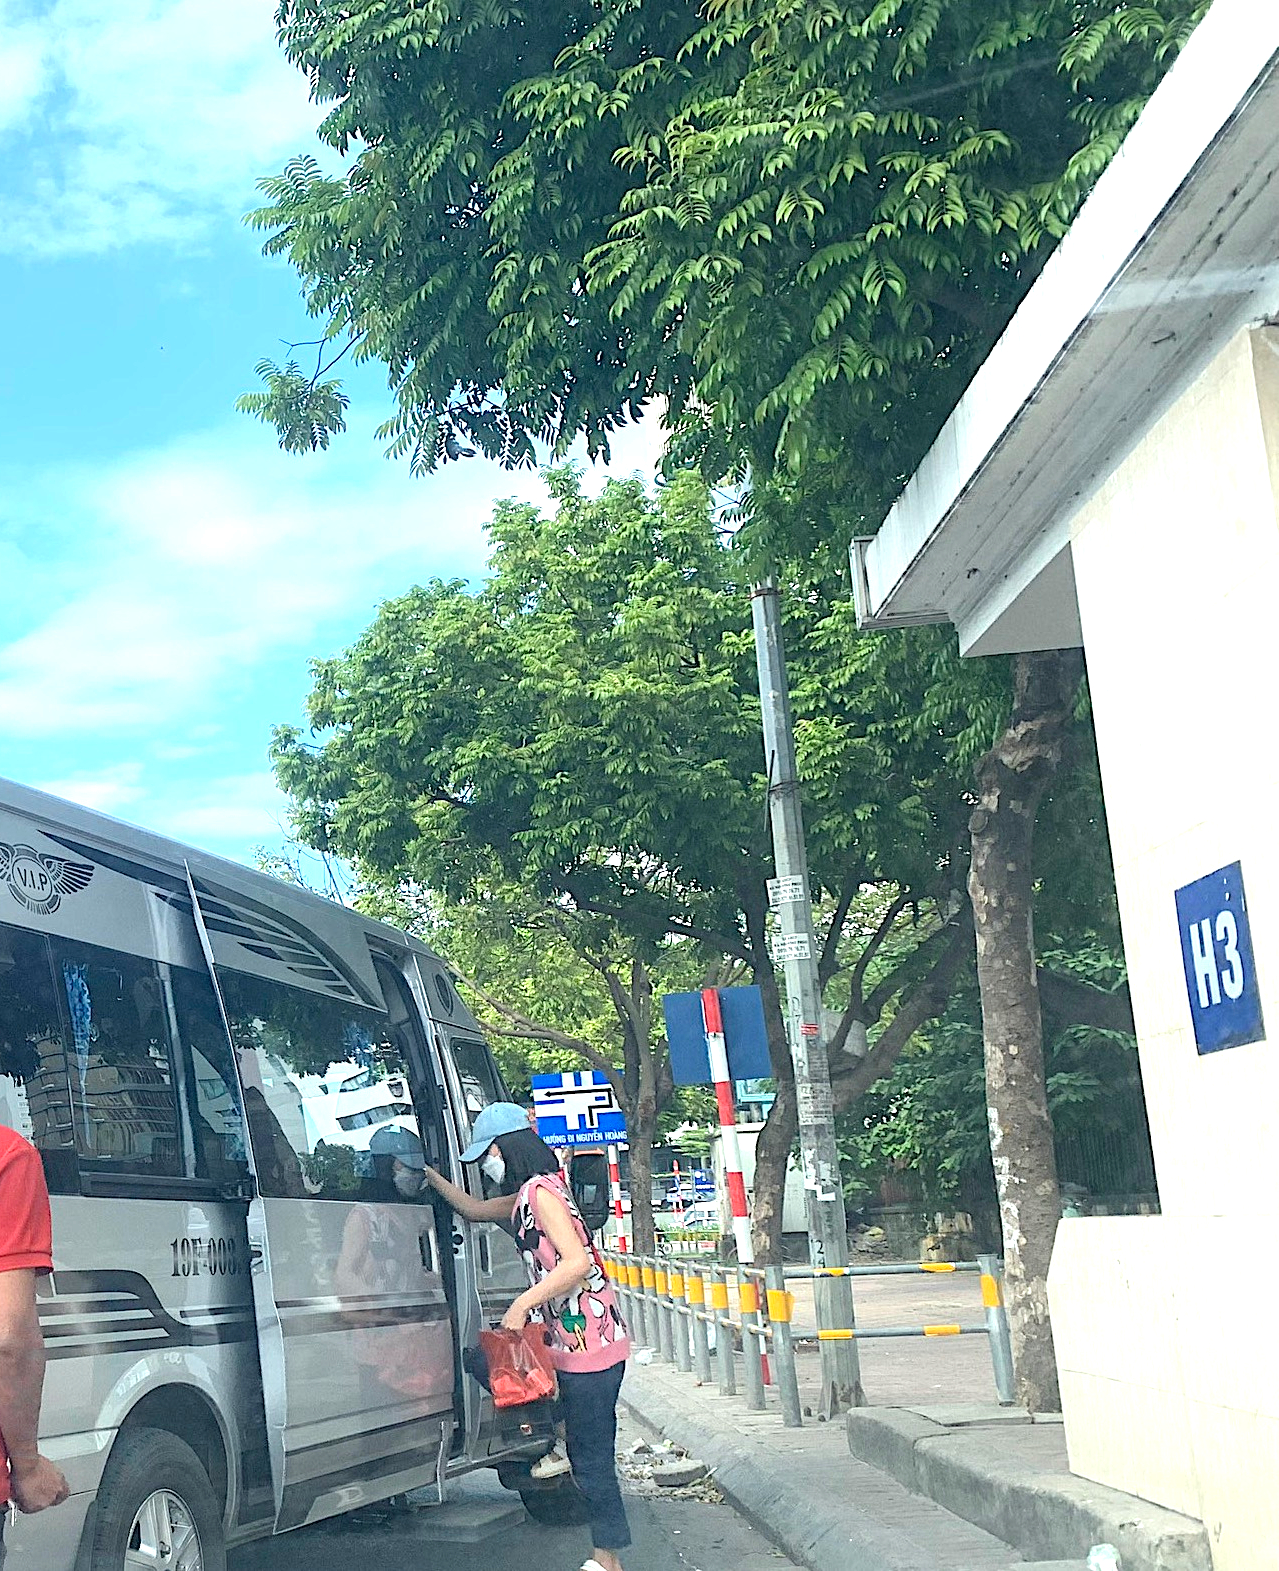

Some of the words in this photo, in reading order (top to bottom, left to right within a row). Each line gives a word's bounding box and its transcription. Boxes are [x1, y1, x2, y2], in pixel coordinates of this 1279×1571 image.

[1188, 909, 1245, 1009] H3
[567, 1134, 575, 1143] ĐI
[575, 1129, 604, 1143] NGUYỄN
[604, 1129, 628, 1141] HOÀNG
